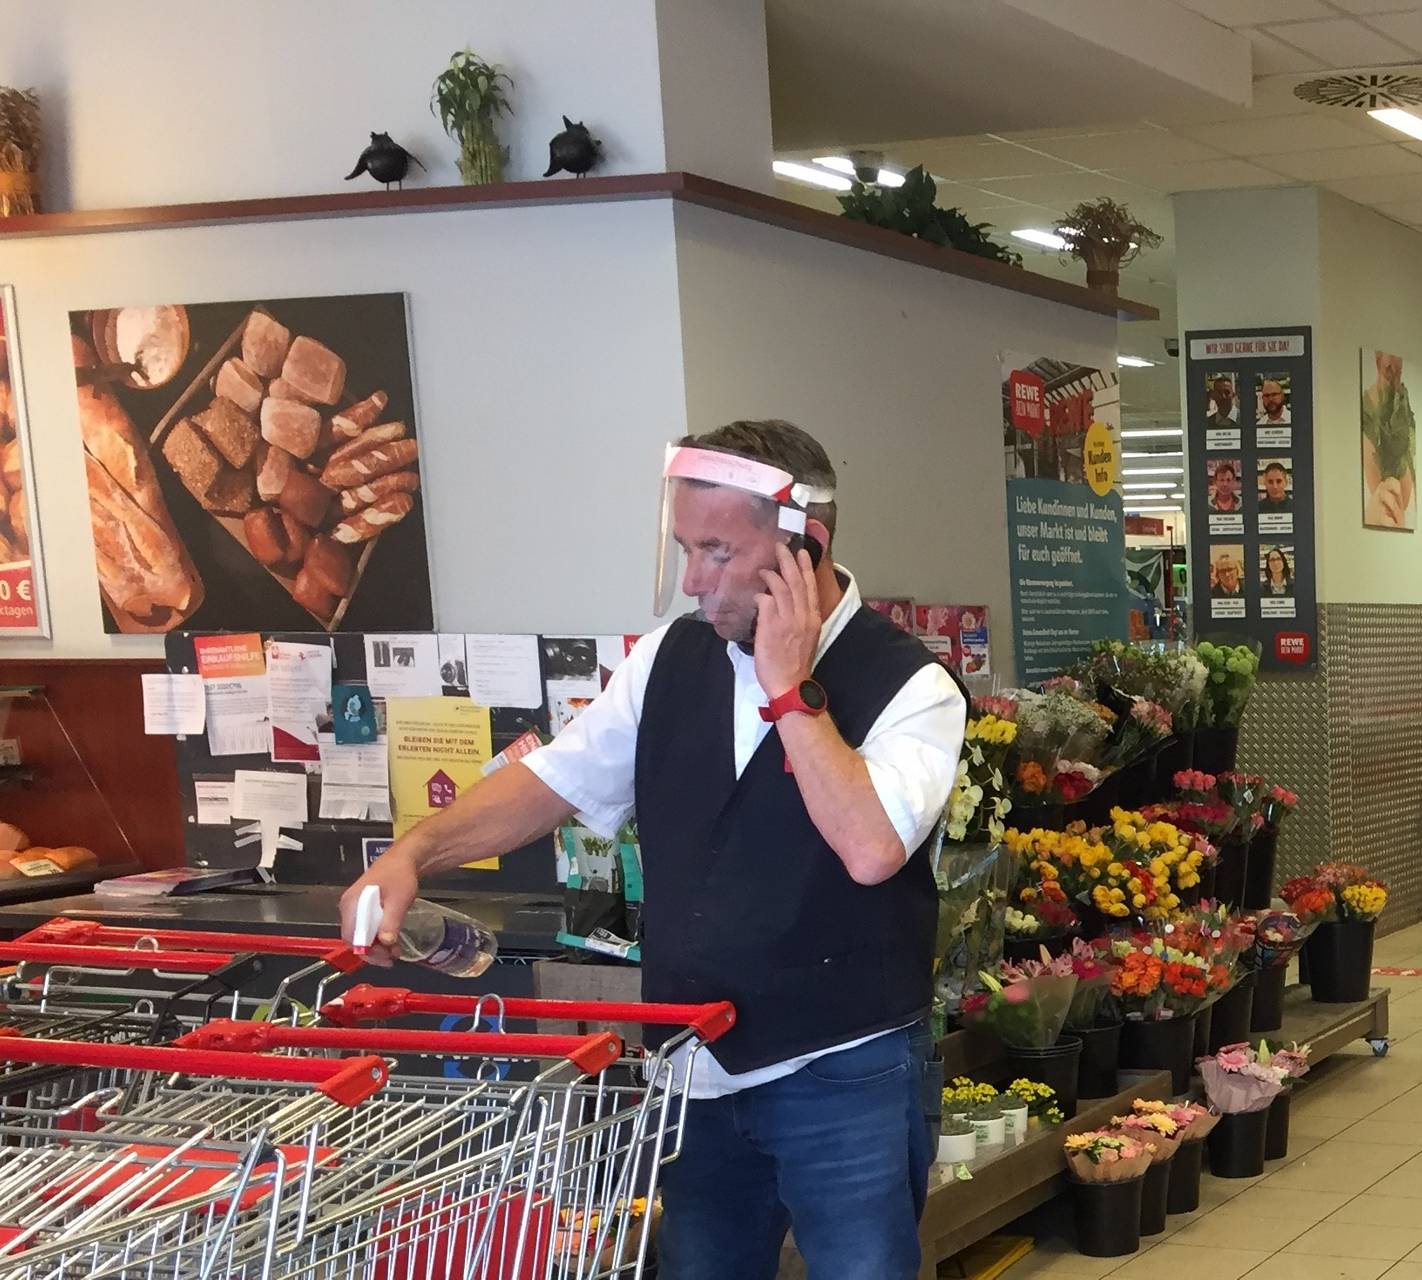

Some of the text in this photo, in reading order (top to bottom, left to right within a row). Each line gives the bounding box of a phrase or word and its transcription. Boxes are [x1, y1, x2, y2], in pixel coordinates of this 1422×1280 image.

[1015, 383, 1040, 401] REWE
[1016, 495, 1037, 514] Liebe
[1076, 503, 1089, 518] und
[1089, 503, 1118, 523] Kunden,
[1017, 521, 1109, 543] unser Markt ist und bleibt
[1018, 544, 1030, 561] für
[1031, 545, 1051, 562] euch
[1280, 638, 1304, 646] REWE
